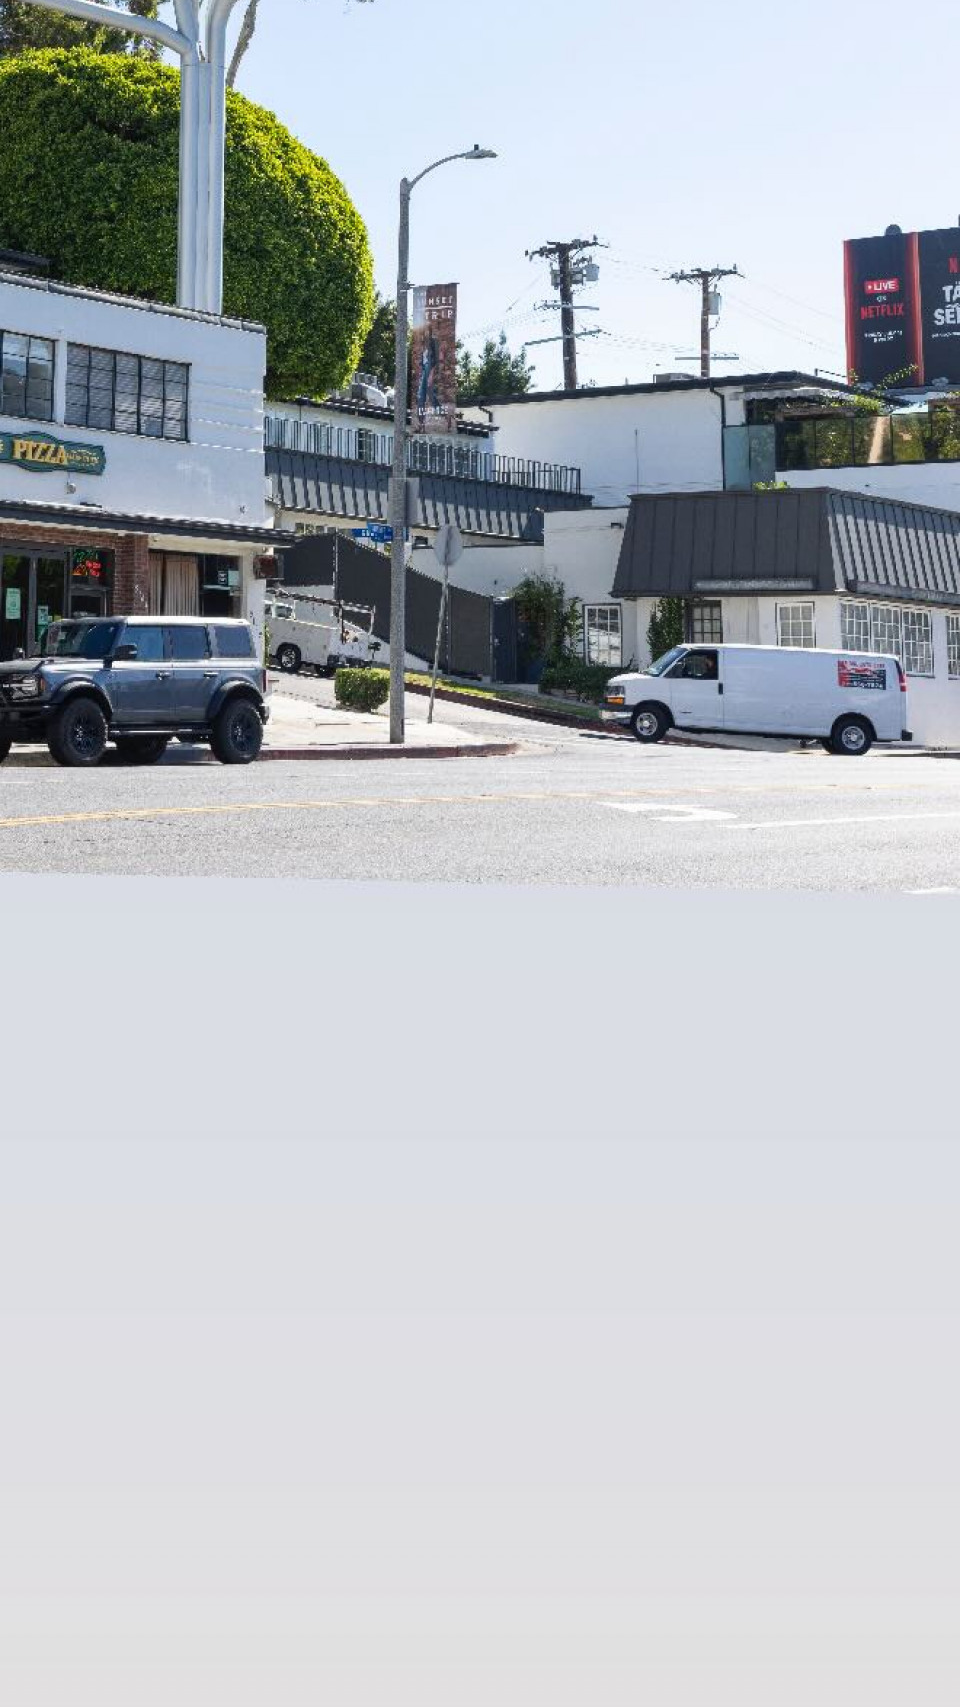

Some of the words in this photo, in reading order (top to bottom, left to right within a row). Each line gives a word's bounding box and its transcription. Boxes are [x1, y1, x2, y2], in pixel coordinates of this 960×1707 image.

[873, 280, 896, 291] LIVE
[861, 302, 904, 320] NETFLIX
[13, 439, 68, 465] PIZZA
